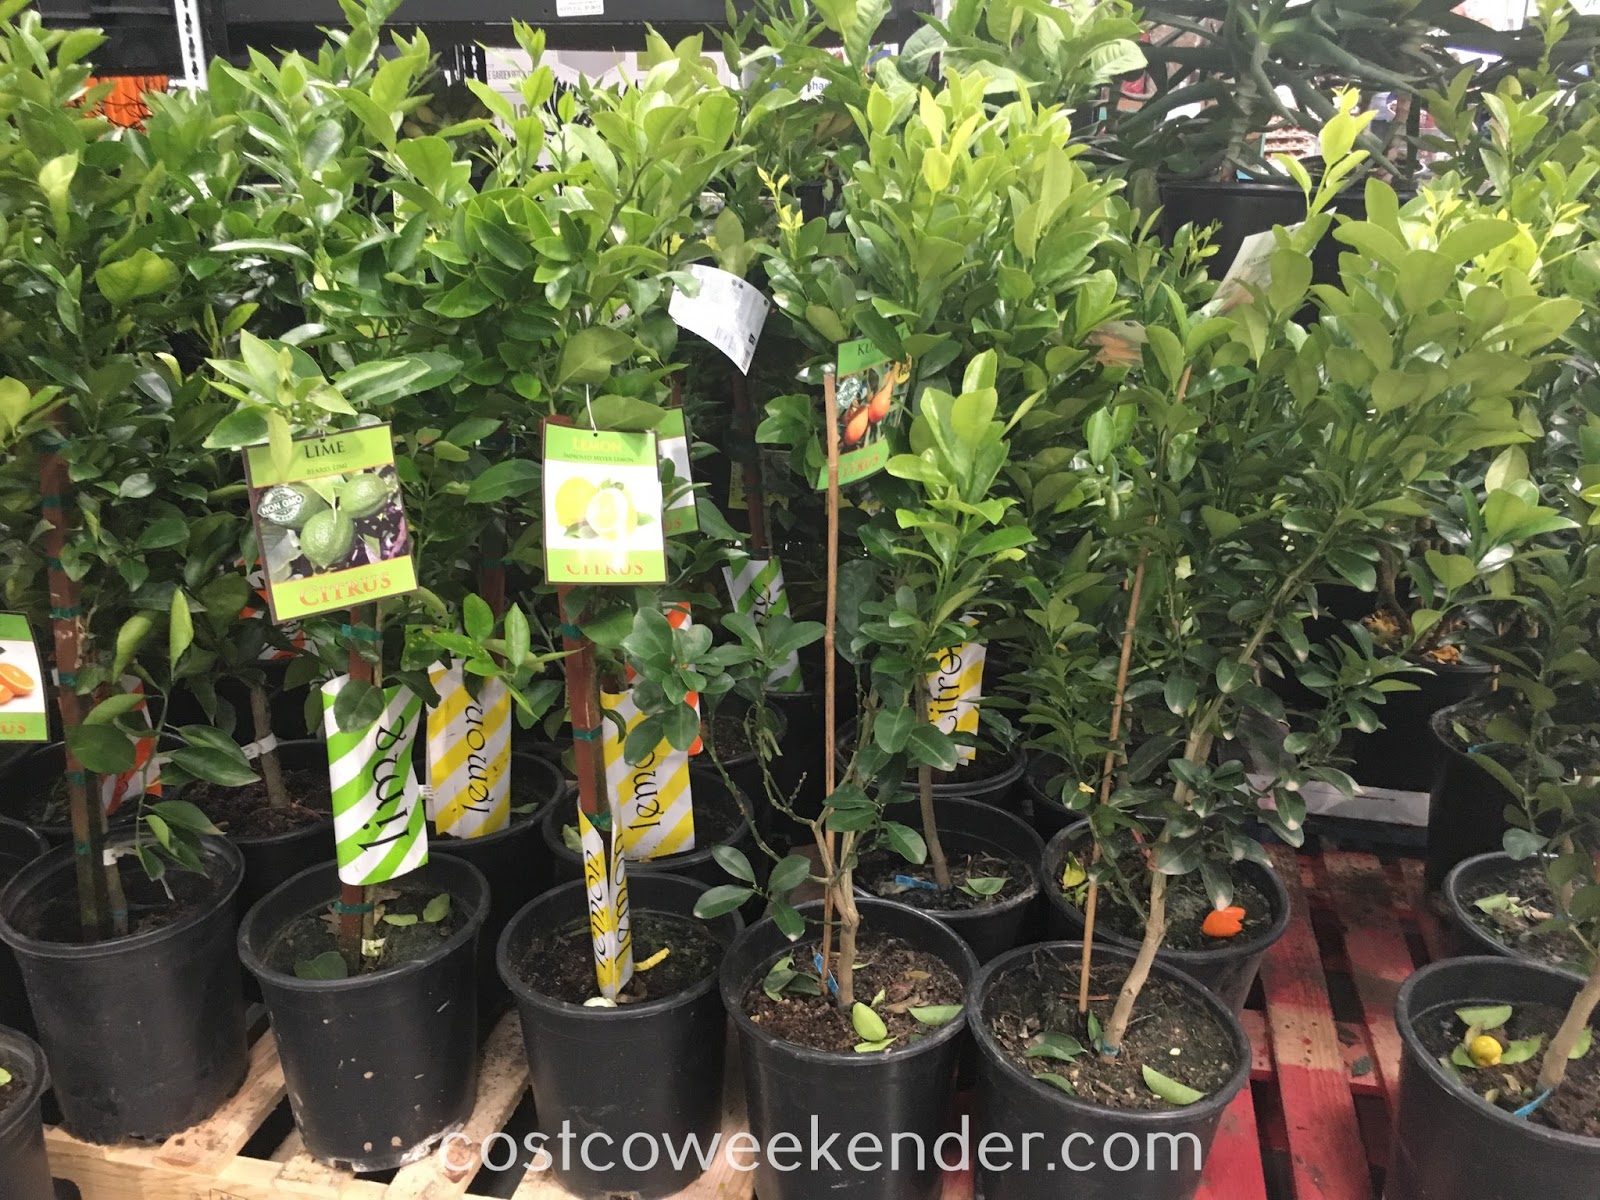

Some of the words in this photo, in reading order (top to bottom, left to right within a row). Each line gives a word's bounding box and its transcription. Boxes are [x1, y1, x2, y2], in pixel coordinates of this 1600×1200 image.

[304, 440, 347, 459] LIME
[572, 437, 622, 452] LEMON
[261, 501, 281, 516] NON
[281, 494, 303, 508] GMO
[566, 559, 644, 576] CITRUS
[299, 571, 392, 607] CITRUS
[462, 701, 496, 814] lemon
[357, 715, 411, 852] lime
[627, 751, 665, 831] lemo
